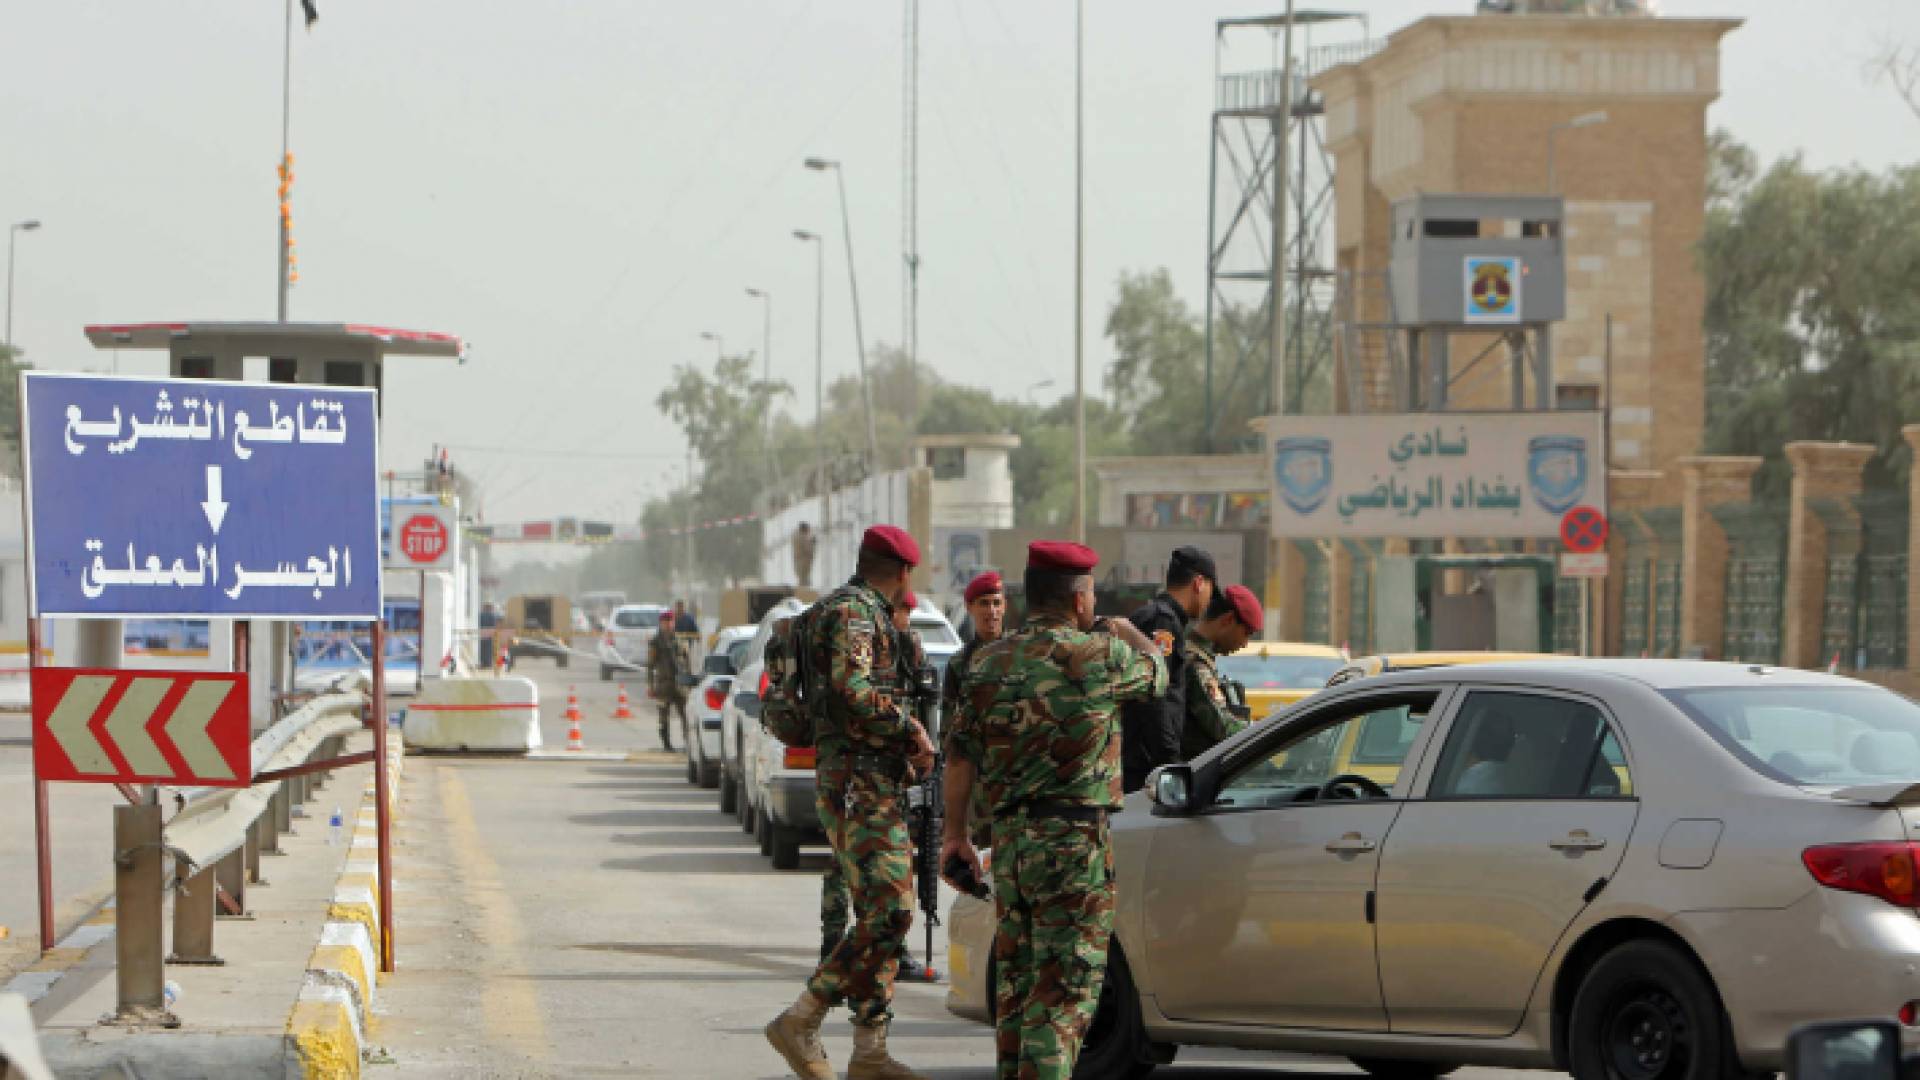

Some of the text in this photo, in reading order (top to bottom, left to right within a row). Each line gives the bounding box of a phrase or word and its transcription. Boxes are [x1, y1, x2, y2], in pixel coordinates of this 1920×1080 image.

[65, 389, 347, 460] تقاطع التشريع
[1389, 424, 1468, 472] نادي
[1338, 474, 1521, 525] بغداد الرياضي
[81, 539, 352, 600] الجسر المعلق
[407, 535, 442, 554] STOP
